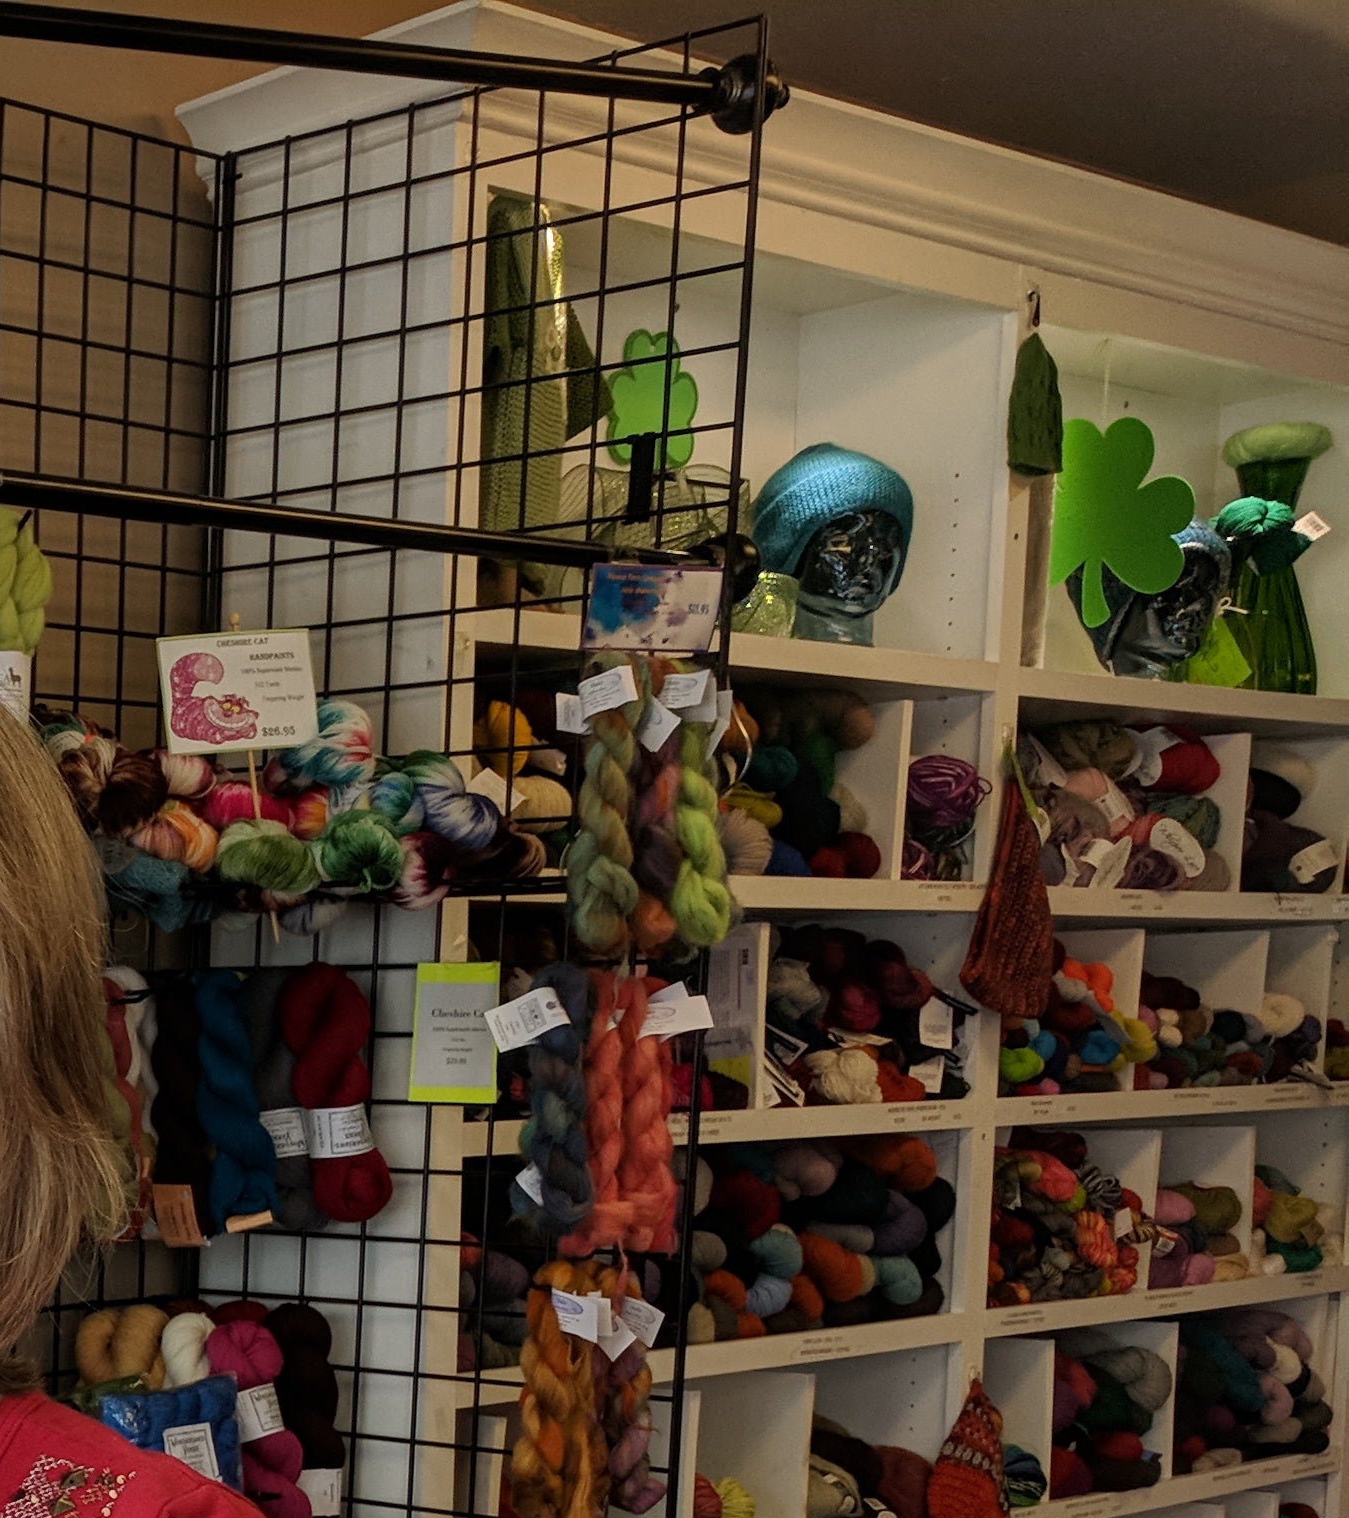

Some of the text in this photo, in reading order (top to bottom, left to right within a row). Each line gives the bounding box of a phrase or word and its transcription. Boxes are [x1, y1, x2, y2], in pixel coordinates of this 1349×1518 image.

[216, 637, 269, 648] CHESHIRE CAT
[249, 651, 295, 661] HANDPAINTS
[261, 725, 296, 737] $26.95
[431, 1008, 485, 1018] Cheshire Ca
